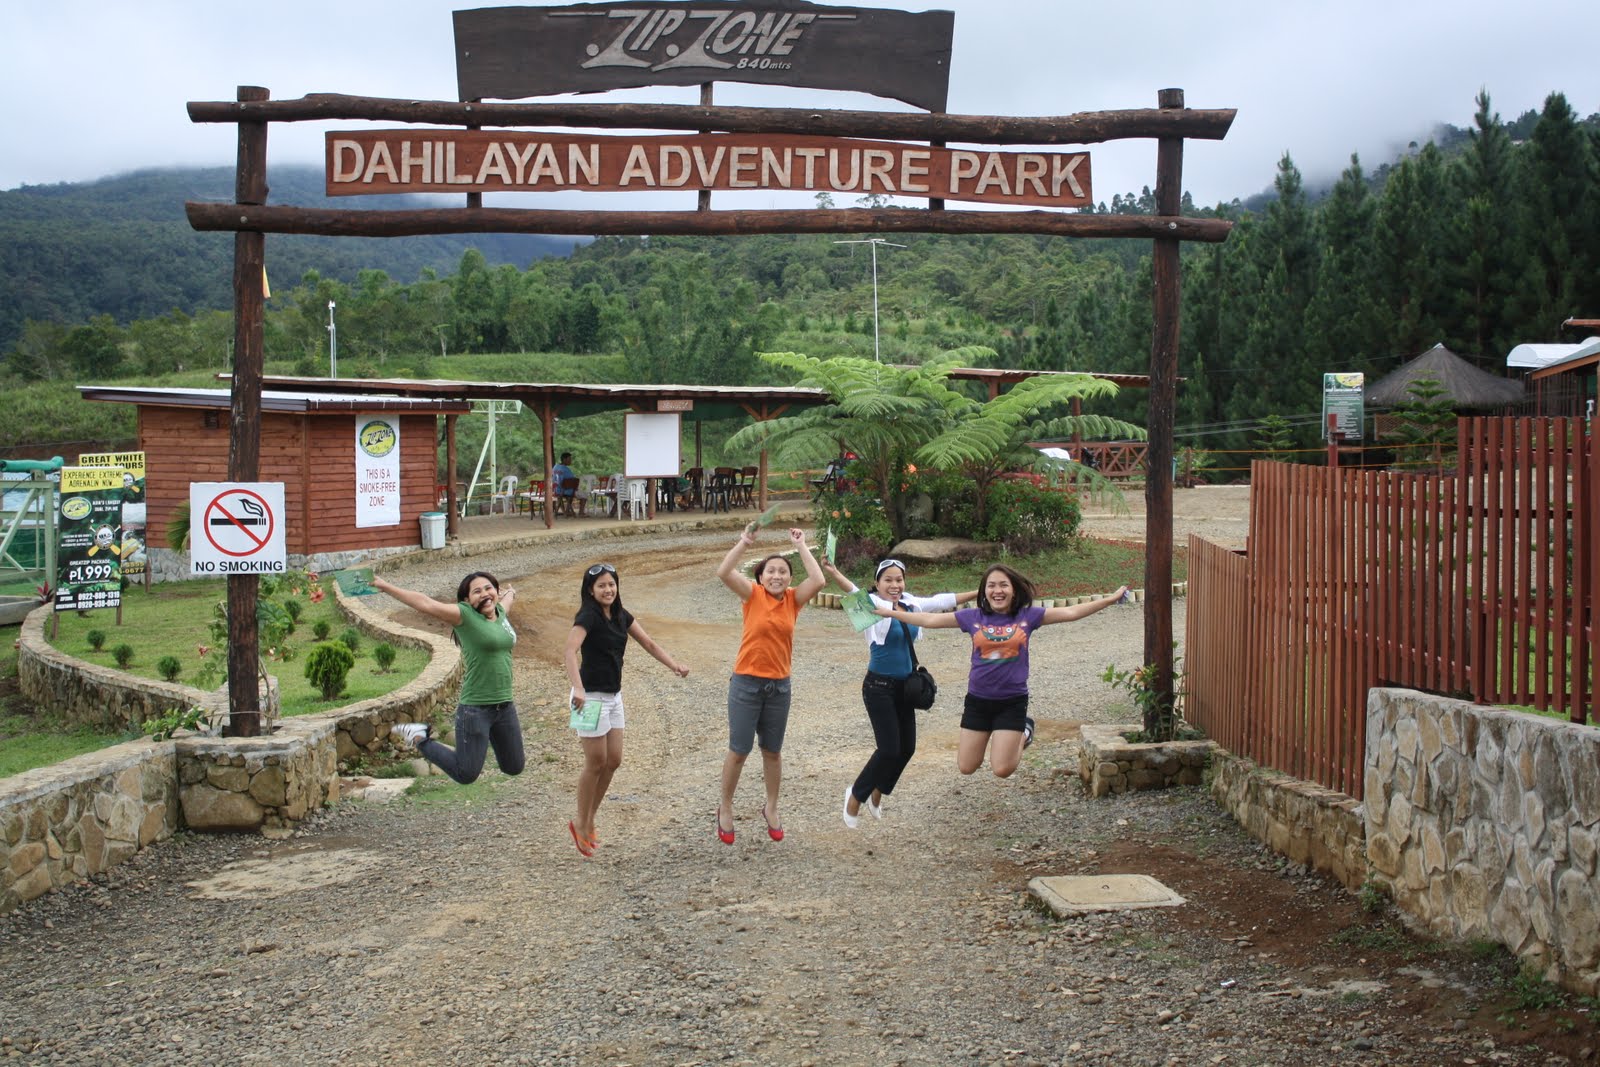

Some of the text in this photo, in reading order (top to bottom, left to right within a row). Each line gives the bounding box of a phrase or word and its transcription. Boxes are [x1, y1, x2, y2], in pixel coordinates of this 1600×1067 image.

[581, 10, 816, 71] ZIP ZONE
[333, 140, 1086, 198] DAHILAYAN ADVENTURE PARK
[81, 453, 143, 464] GREAT WHITE
[64, 470, 122, 480] EXPERIENCE EXTREME
[366, 469, 391, 479] THIS IS A
[69, 480, 99, 488] ADRENALIN
[360, 482, 396, 493] SMOKE-FREE
[369, 496, 385, 506] ZONE
[195, 561, 283, 572] NO SMOKING
